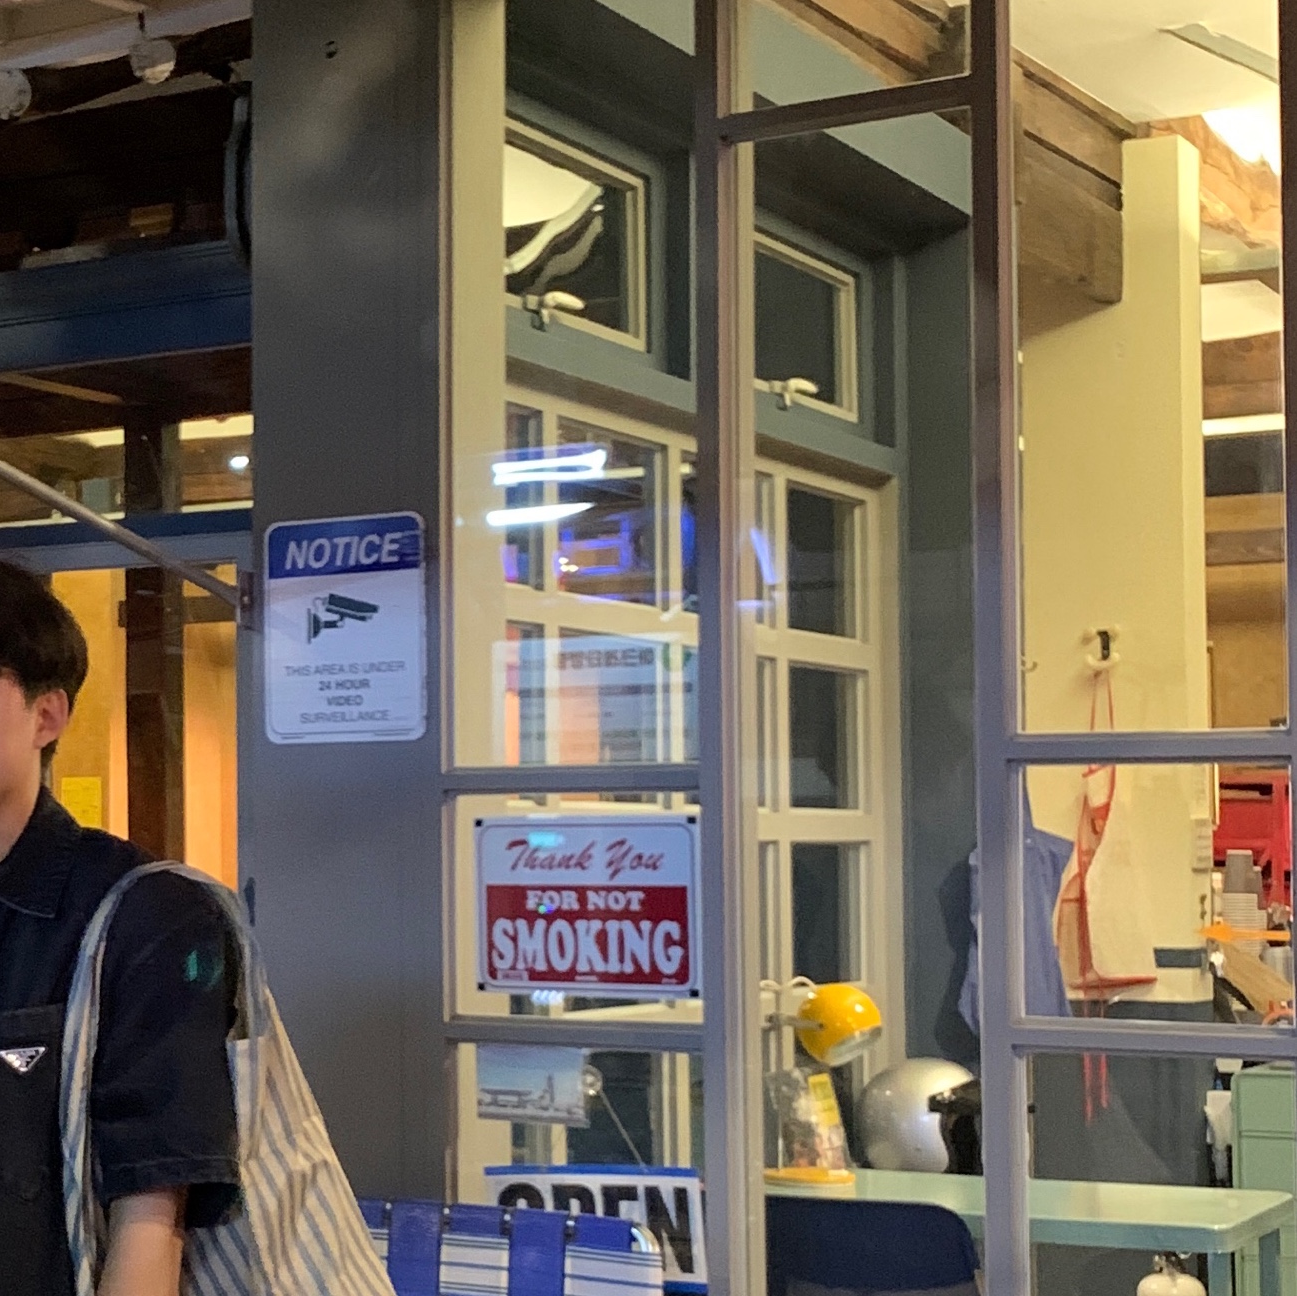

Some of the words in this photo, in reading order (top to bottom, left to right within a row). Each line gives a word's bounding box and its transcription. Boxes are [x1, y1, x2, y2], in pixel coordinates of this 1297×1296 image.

[284, 533, 402, 570] NOTICE
[285, 665, 312, 677] THIS
[314, 663, 346, 676] AREA
[348, 663, 360, 675] IS
[364, 661, 406, 674] UNDER
[318, 680, 332, 691] 24
[335, 679, 371, 691] HOUR
[326, 695, 364, 706] VIDEO
[299, 709, 390, 724] SURVEILLANCE
[505, 837, 597, 872] Thank
[605, 837, 665, 881] You
[526, 890, 580, 911] FOR
[587, 890, 645, 911] NOT
[491, 917, 685, 976] SMOKING
